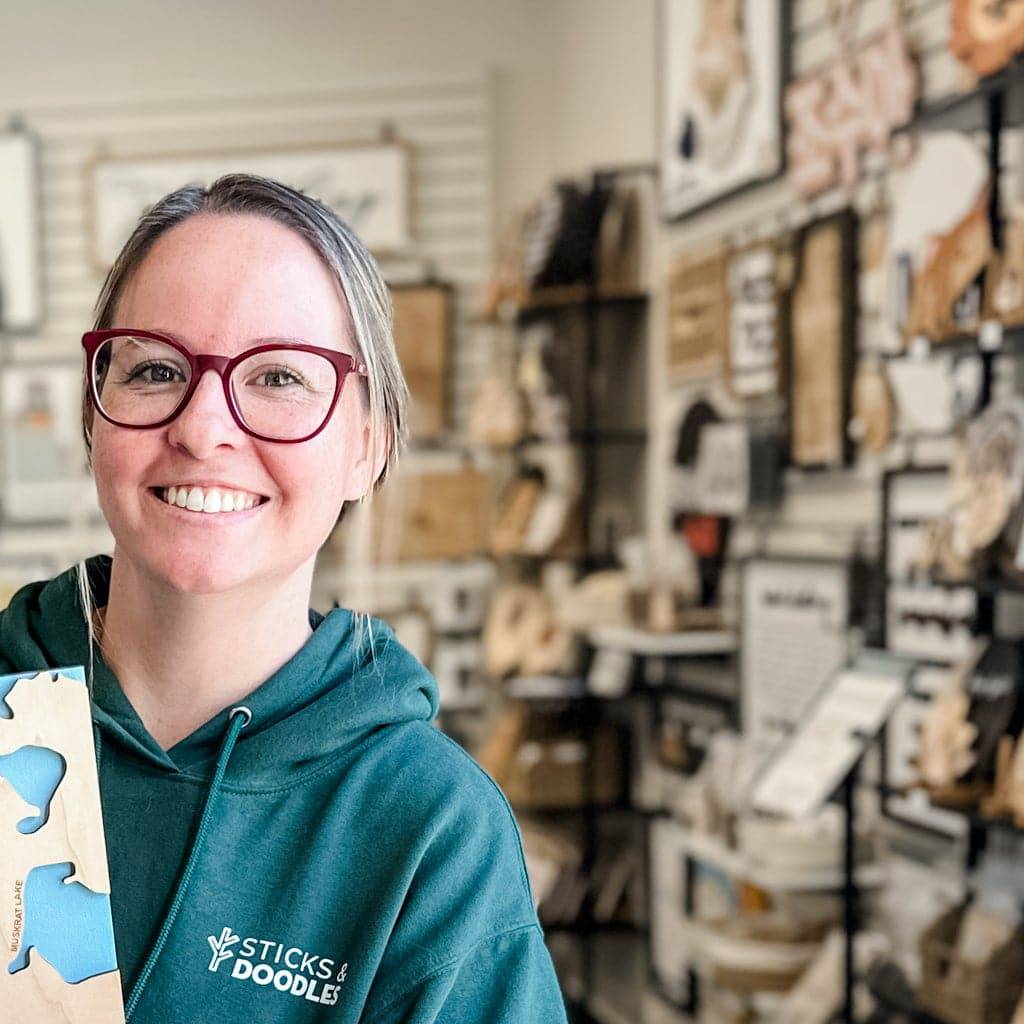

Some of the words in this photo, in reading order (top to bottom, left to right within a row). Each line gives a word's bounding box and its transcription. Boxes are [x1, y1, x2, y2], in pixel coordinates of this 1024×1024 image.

[14, 880, 23, 906] LAKE
[9, 909, 23, 952] MUSKRAT
[239, 938, 335, 980] STICKS
[337, 963, 348, 982] &
[231, 958, 342, 1006] DOODLES
